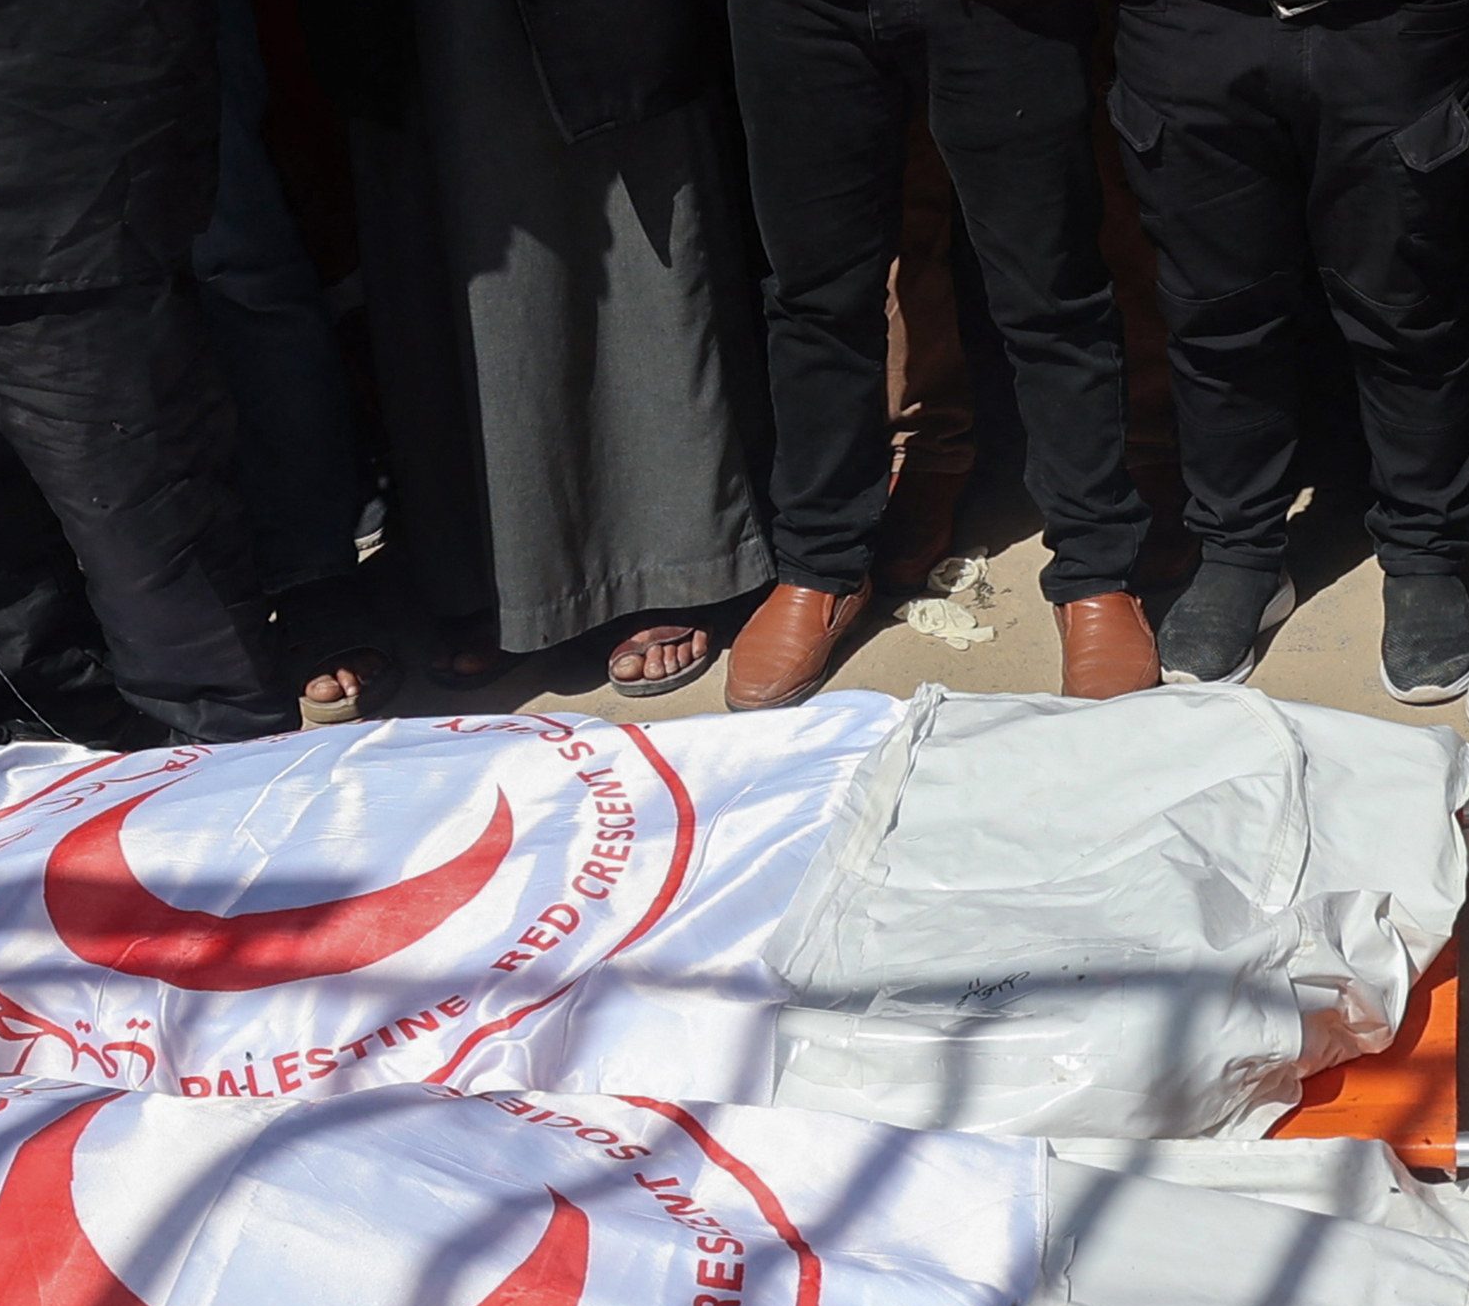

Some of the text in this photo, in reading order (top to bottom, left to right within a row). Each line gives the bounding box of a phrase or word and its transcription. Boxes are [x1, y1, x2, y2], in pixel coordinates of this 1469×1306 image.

[180, 994, 472, 1097] PALESTINE
[491, 901, 581, 975] RED
[573, 767, 635, 902] CRESCENT
